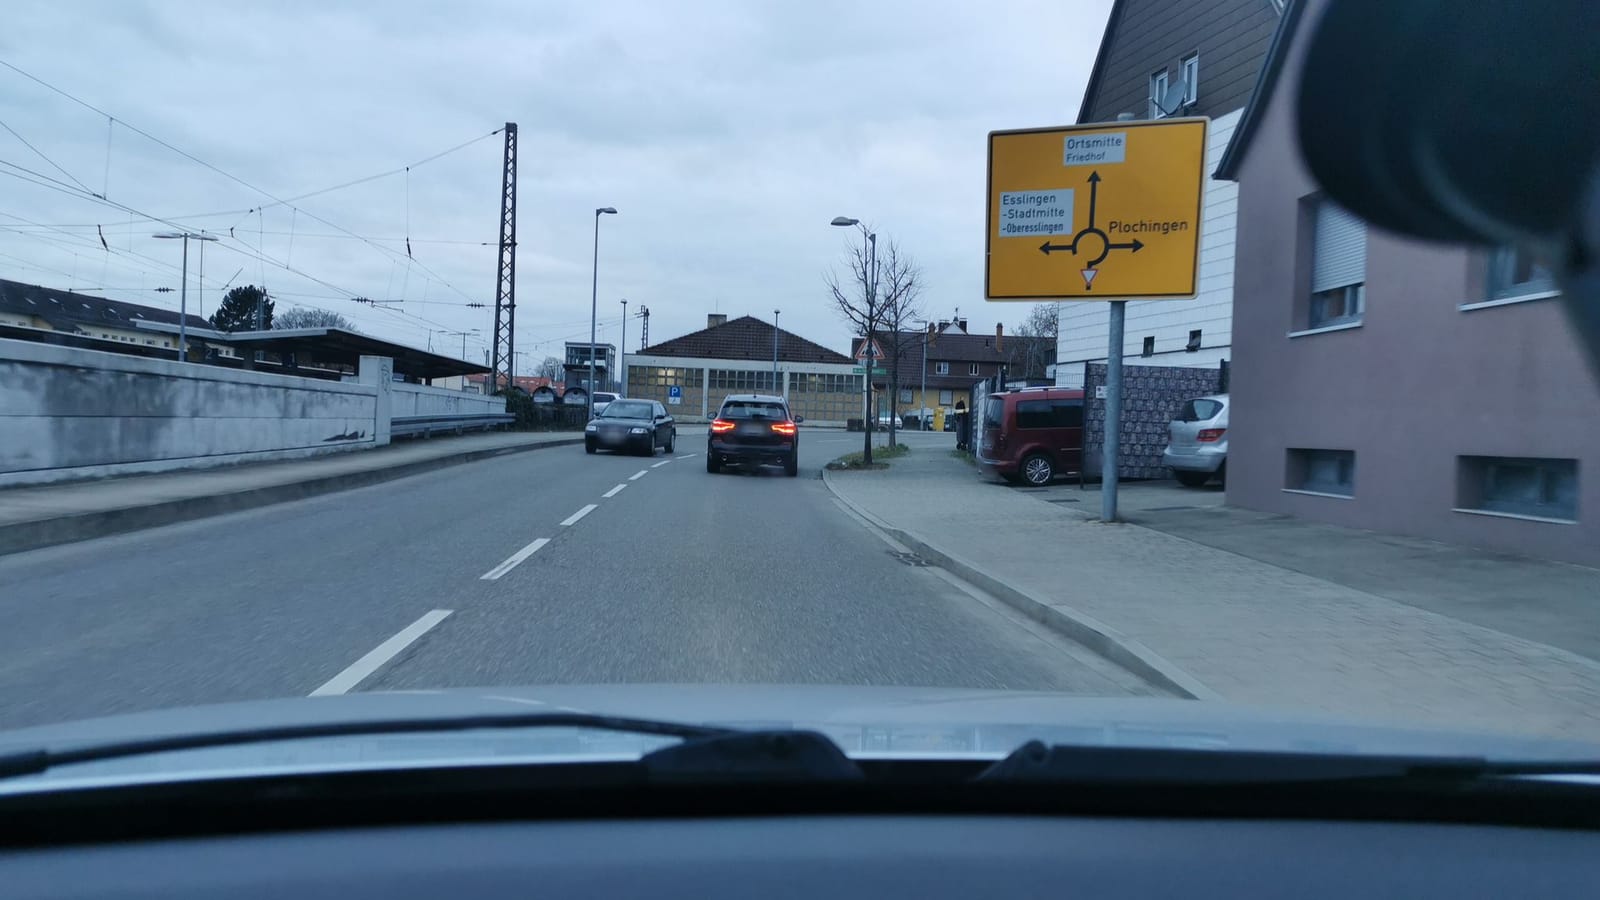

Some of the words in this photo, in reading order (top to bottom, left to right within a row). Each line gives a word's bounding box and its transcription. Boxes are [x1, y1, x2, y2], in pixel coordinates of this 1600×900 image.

[1067, 136, 1122, 149] Ortsmitte
[1066, 151, 1106, 162] Friedhof
[1002, 194, 1056, 206] Esslingen
[1002, 207, 1065, 219] -Stadtmitte
[1109, 220, 1188, 235] Plochingen
[671, 387, 679, 396] P
